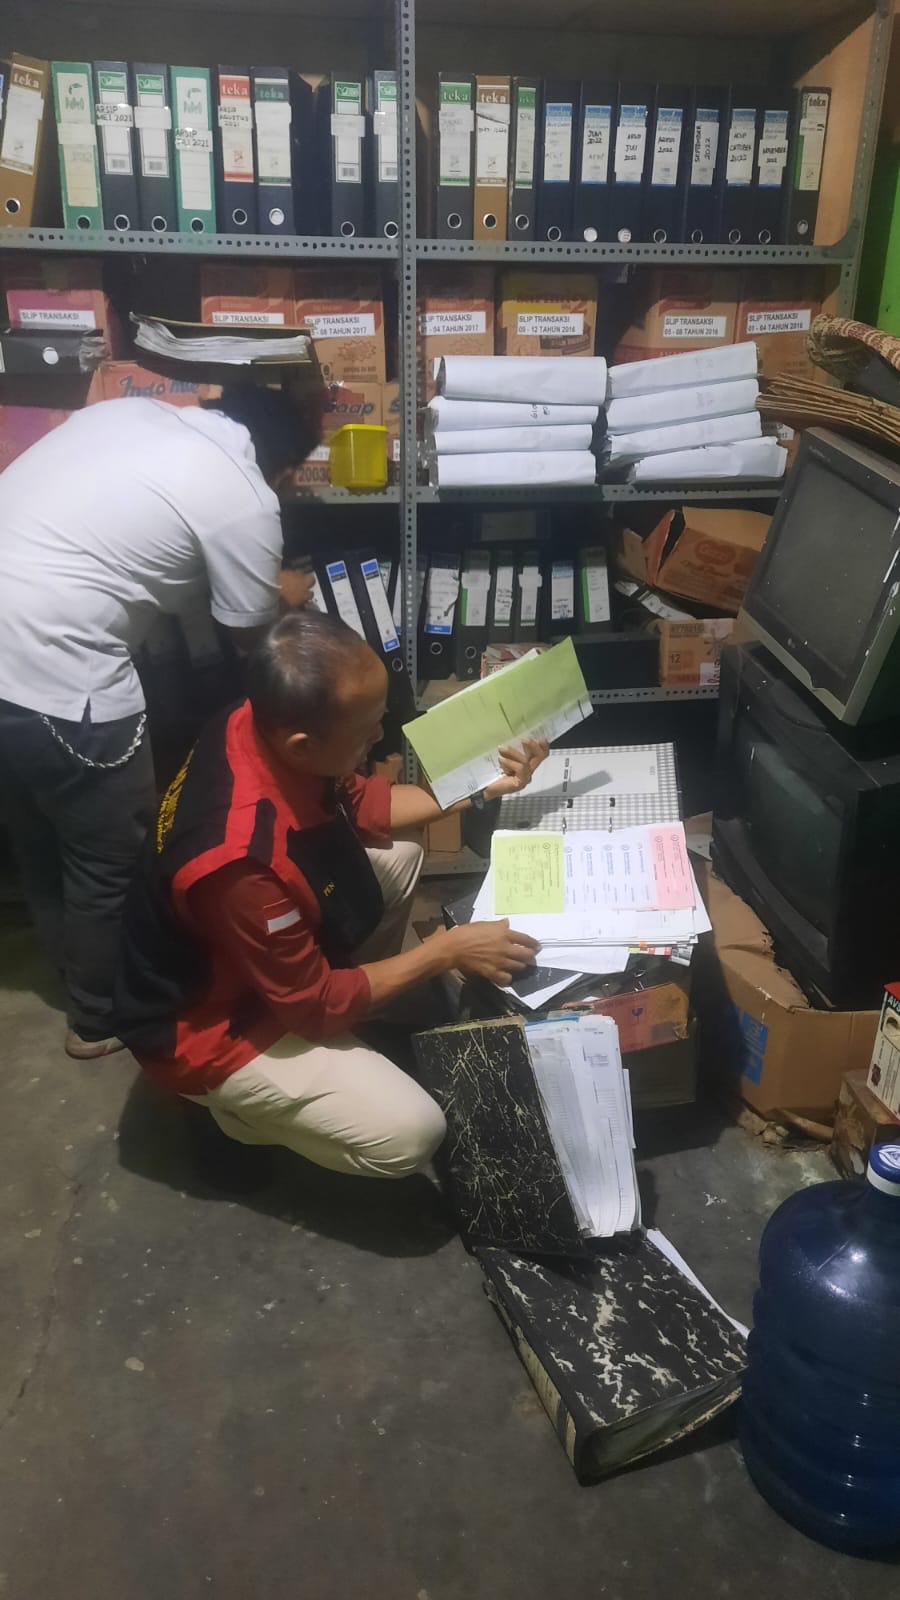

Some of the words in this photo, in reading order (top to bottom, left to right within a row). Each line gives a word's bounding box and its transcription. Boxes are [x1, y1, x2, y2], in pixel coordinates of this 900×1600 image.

[13, 73, 40, 89] teka
[221, 83, 248, 96] teka
[260, 88, 285, 99] teka
[443, 89, 468, 101] teka
[481, 90, 506, 103] teka
[114, 114, 133, 122] 2021
[39, 312, 80, 321] TRANSAKSI
[231, 315, 270, 323] TRANSAKSI
[322, 316, 361, 325] TRANSAKSI
[435, 313, 473, 322] TRANSAKSI
[519, 315, 533, 323] SLIP
[534, 315, 570, 323] TRANSAKSI
[749, 314, 763, 322] SLIP
[763, 312, 799, 321] TRANSAKSI
[665, 318, 679, 326] SLIP
[679, 318, 714, 326] TRANSAKSI
[768, 322, 789, 330] TAHUN
[329, 327, 352, 335] TAHUN
[352, 326, 367, 335] 2017
[442, 325, 464, 333] TAHUN
[465, 324, 479, 332] 2017
